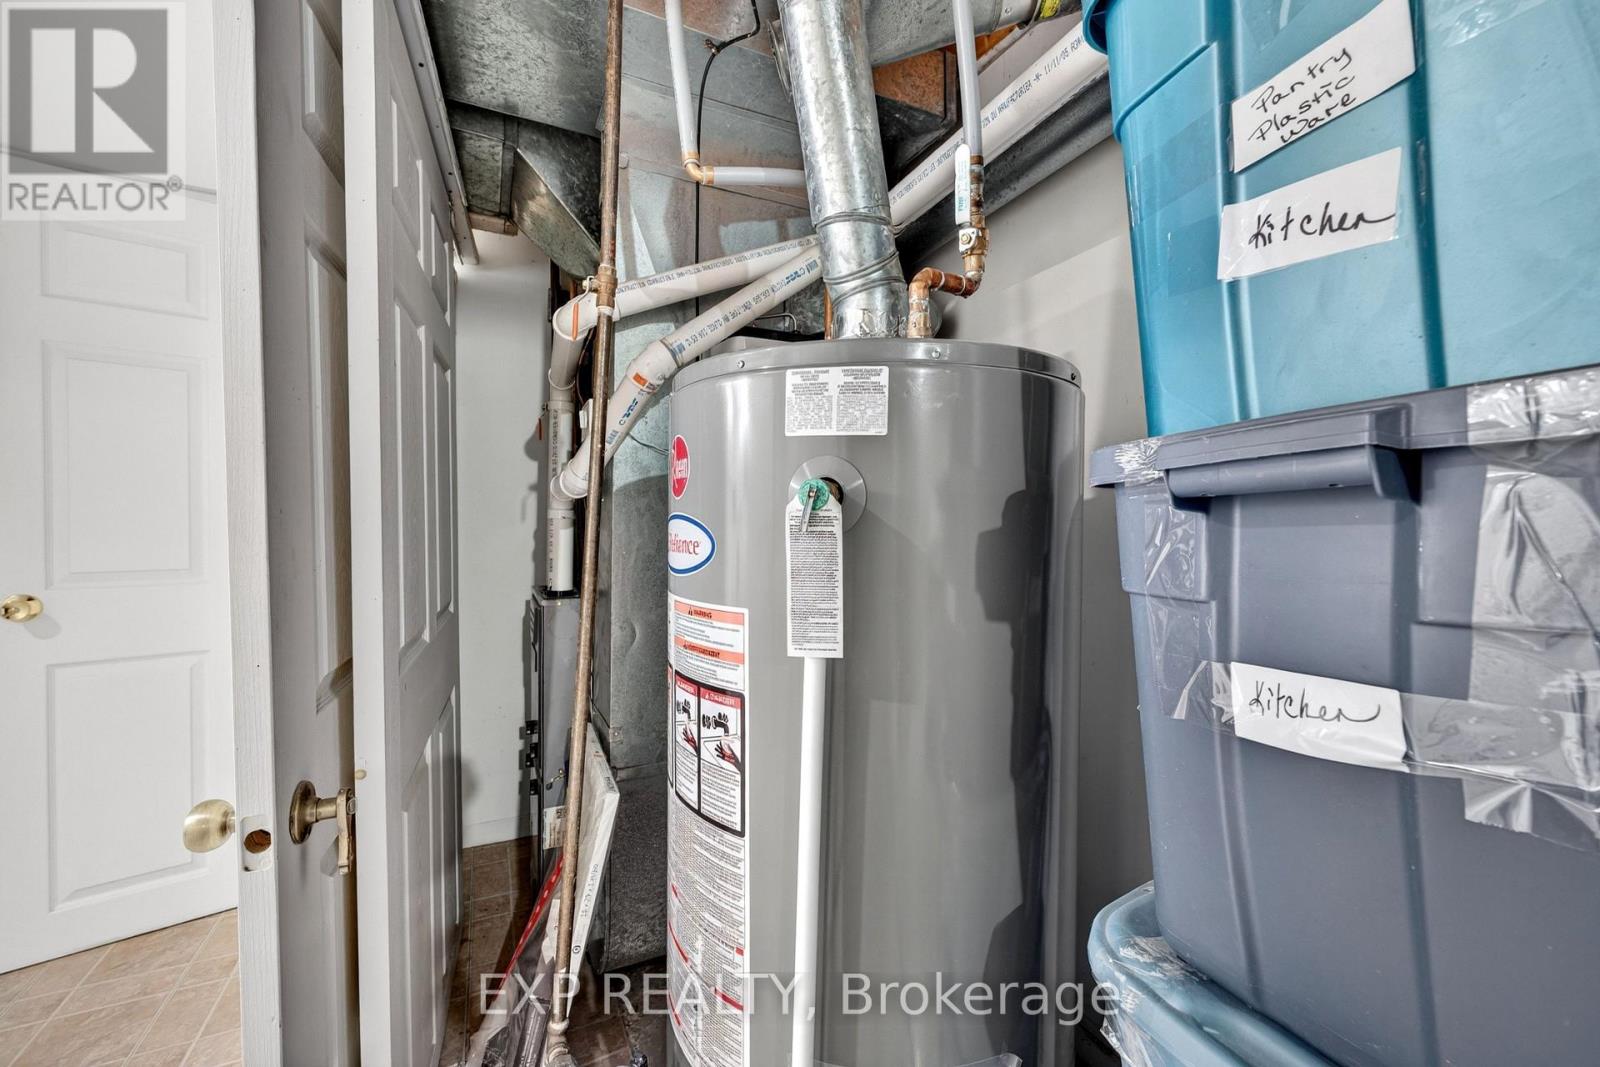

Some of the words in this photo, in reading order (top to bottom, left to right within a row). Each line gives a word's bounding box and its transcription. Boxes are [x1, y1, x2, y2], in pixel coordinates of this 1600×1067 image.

[1248, 75, 1355, 142] Plastic
[1251, 48, 1353, 113] Pantry
[1249, 202, 1396, 249] Kitchen
[1249, 681, 1381, 723] Kitchen
